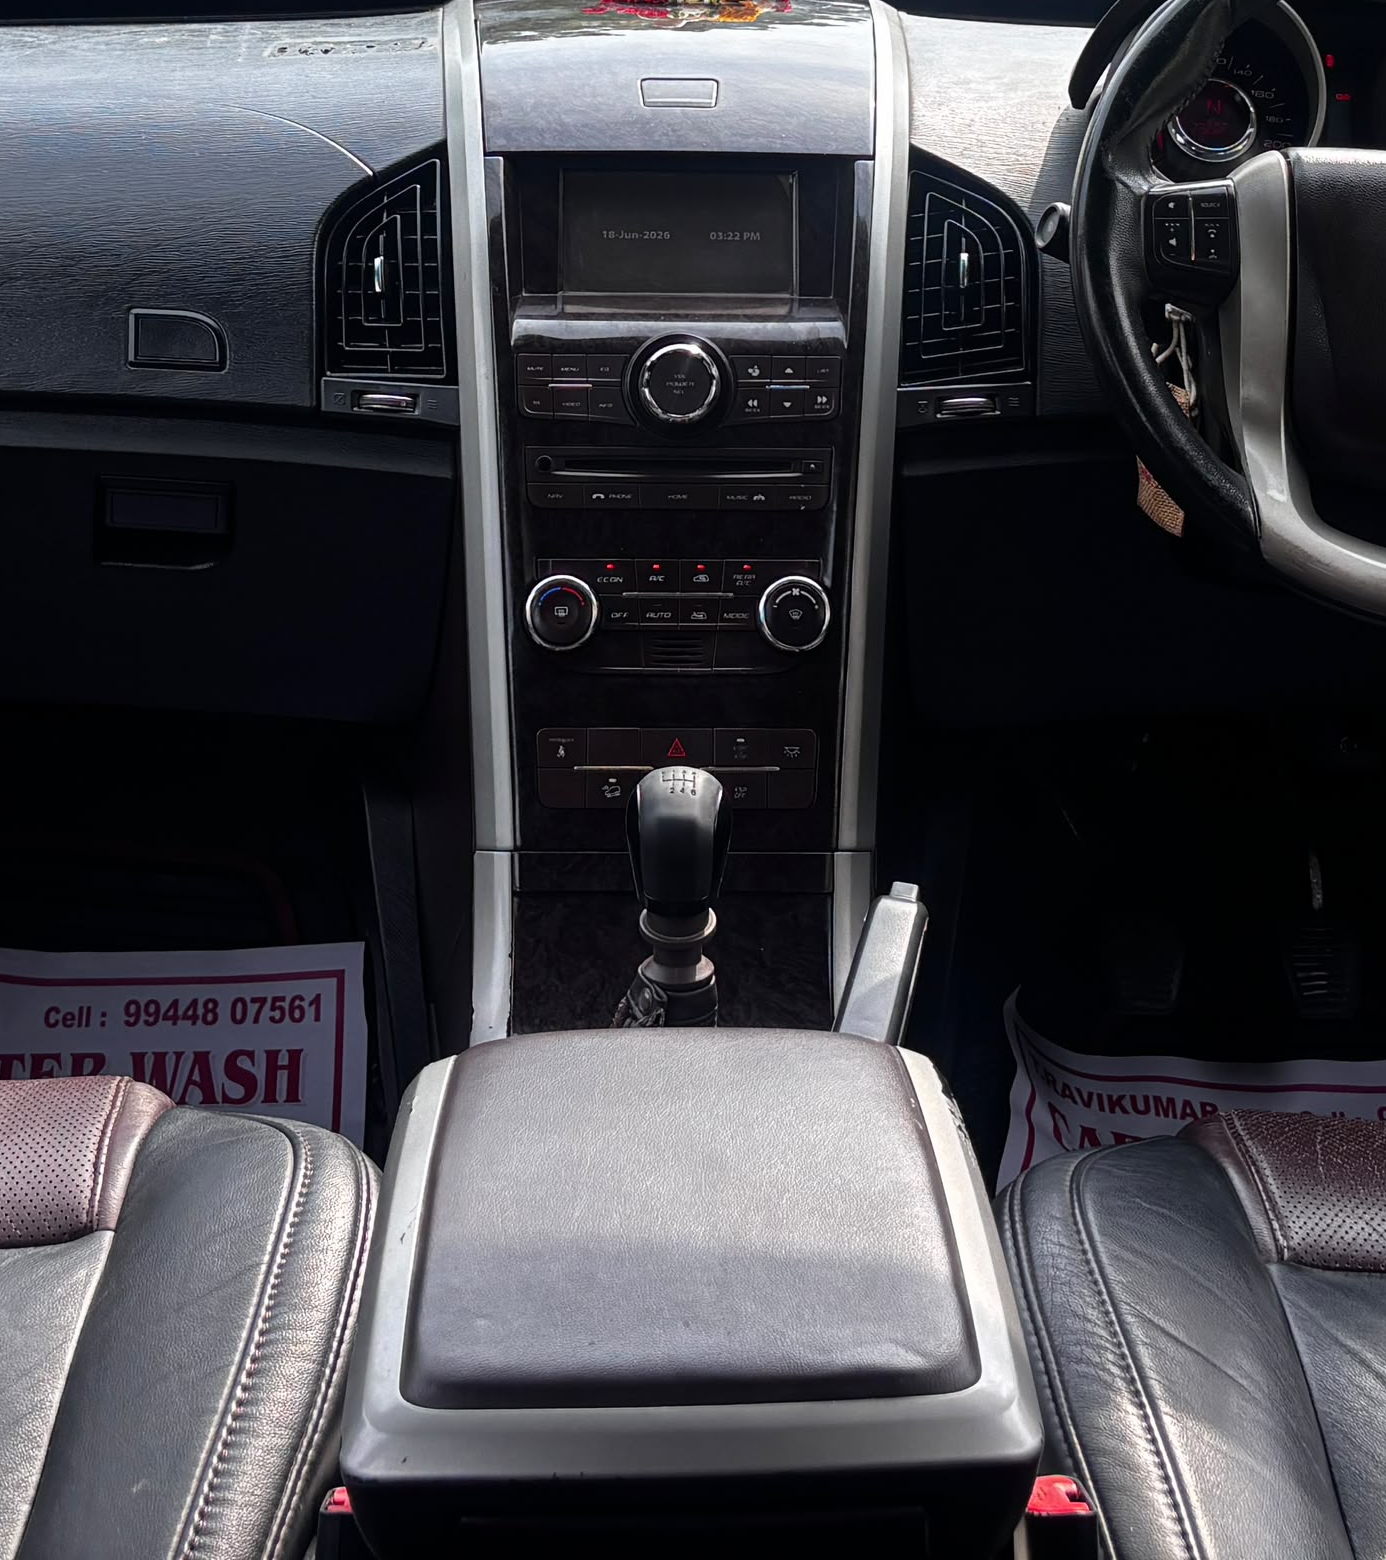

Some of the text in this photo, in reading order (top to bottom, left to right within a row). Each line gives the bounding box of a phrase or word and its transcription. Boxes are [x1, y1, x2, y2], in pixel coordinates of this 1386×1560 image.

[709, 231, 741, 241] 03:22
[743, 231, 761, 241] PM
[610, 611, 630, 619] OFF
[645, 611, 672, 619] AUTO
[44, 1005, 91, 1028] Cell
[123, 998, 219, 1028] 99448
[230, 993, 322, 1025] 07561
[130, 1049, 304, 1105] WASH
